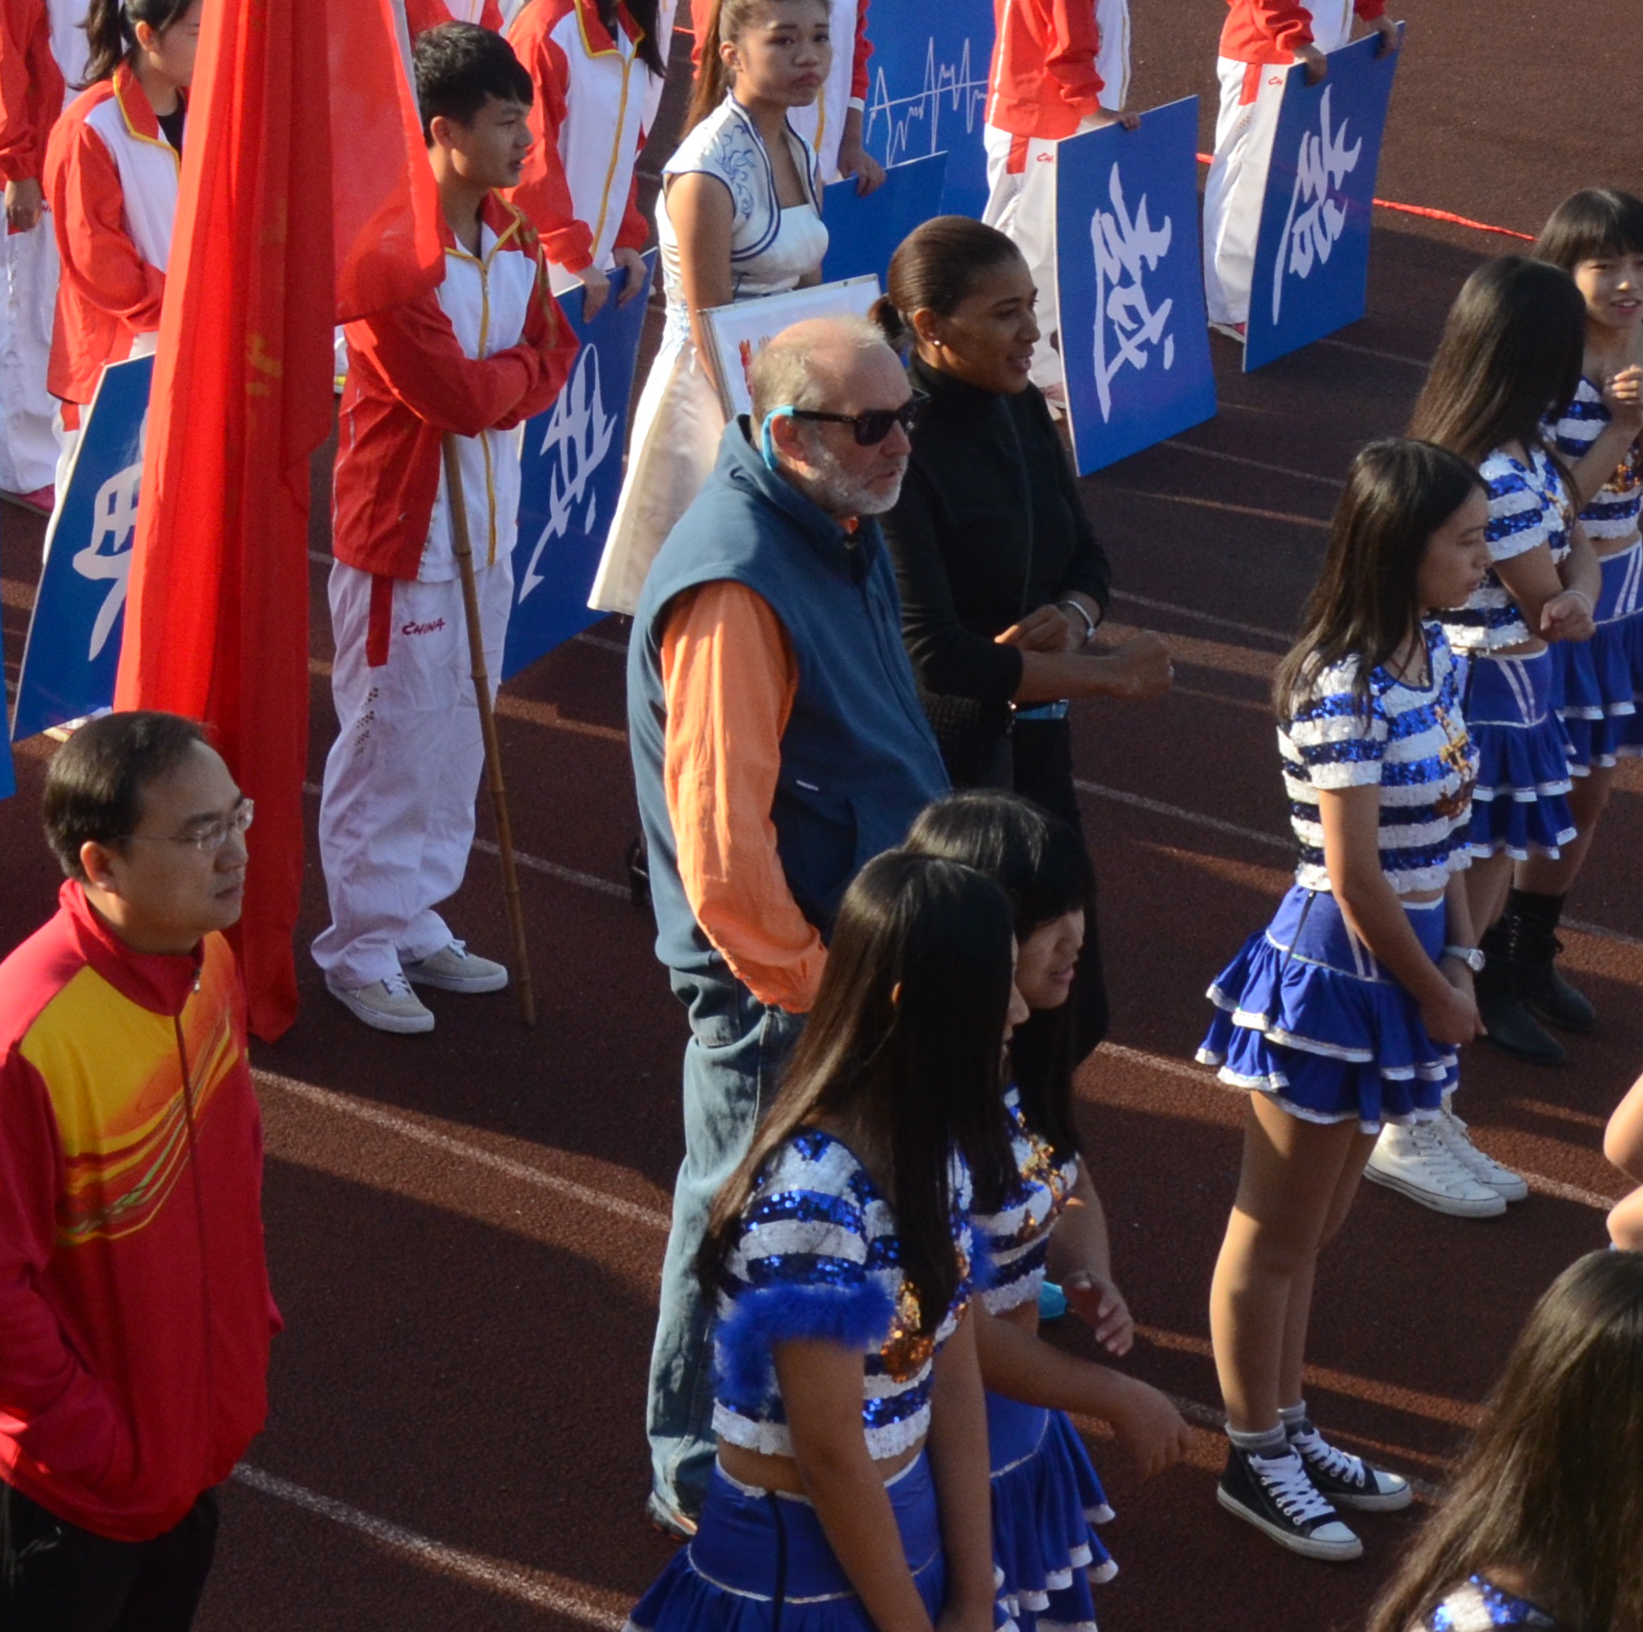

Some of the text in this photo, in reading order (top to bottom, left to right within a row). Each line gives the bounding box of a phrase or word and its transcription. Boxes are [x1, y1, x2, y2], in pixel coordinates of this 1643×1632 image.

[1090, 163, 1173, 422] 越
[1272, 84, 1362, 325] 超
[402, 616, 446, 636] CHINA
